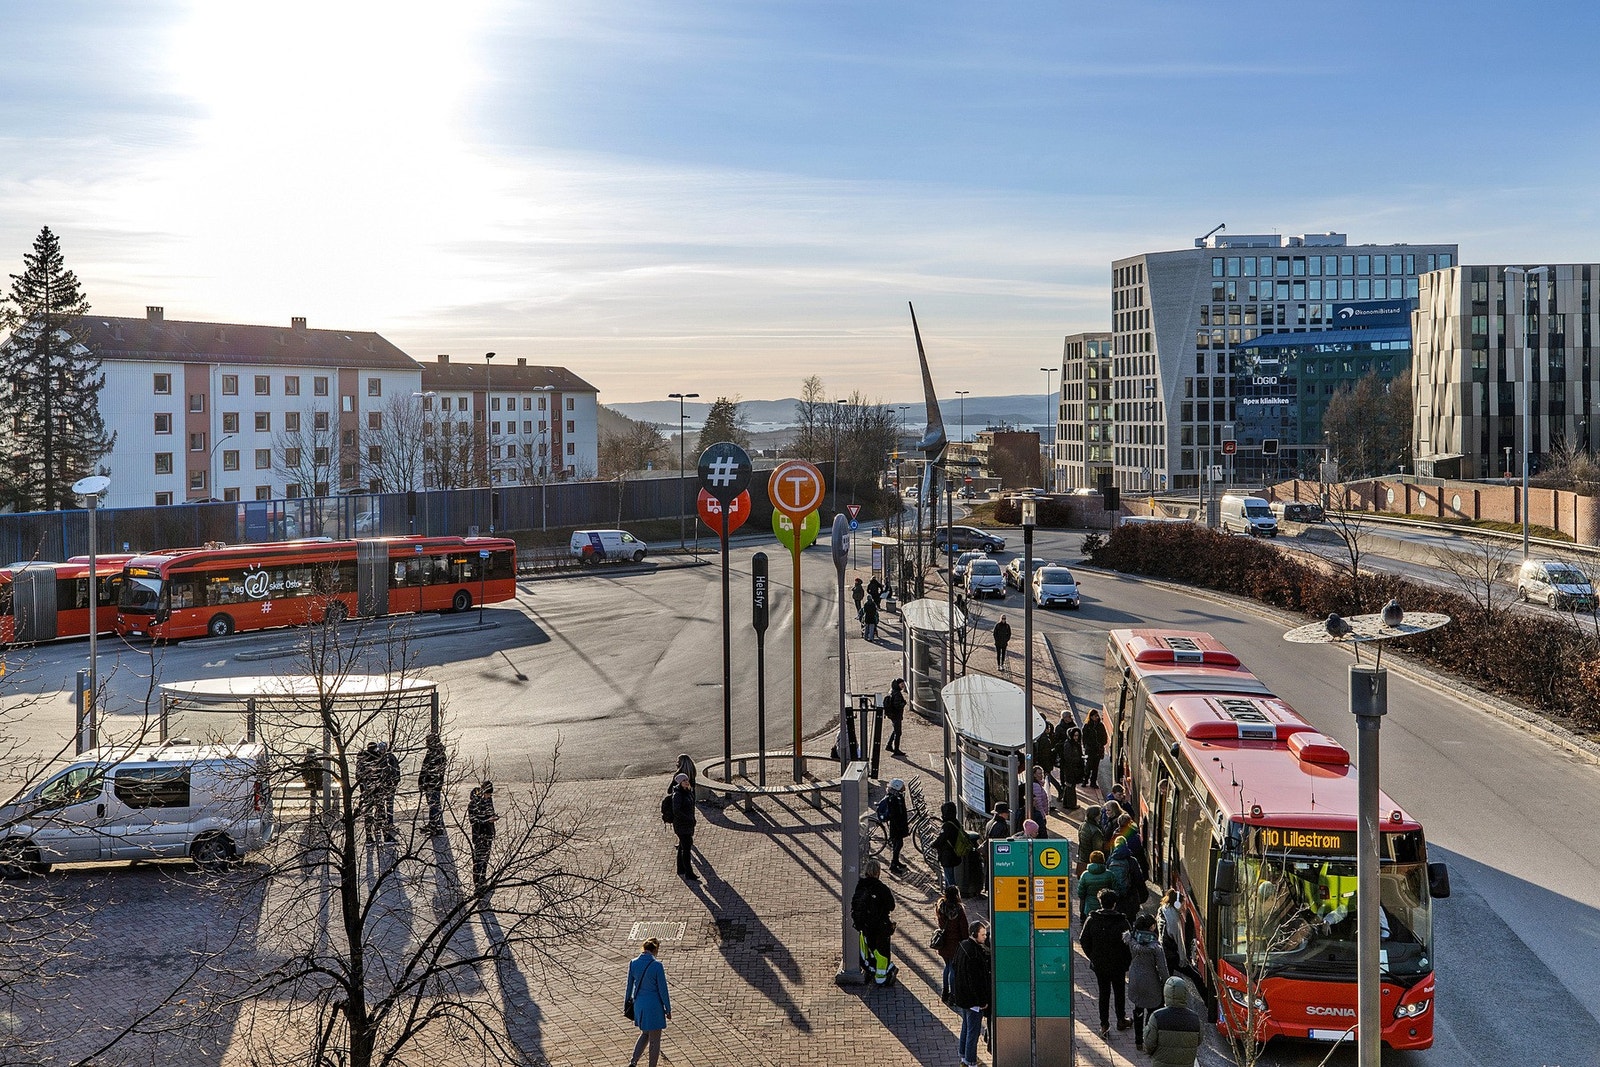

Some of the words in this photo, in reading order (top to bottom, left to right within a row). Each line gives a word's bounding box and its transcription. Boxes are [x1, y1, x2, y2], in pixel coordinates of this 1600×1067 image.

[1253, 377, 1277, 385] LOGIQ
[785, 476, 808, 506] T
[231, 584, 244, 595] Jeg
[755, 575, 766, 608] Helsfyr
[1283, 830, 1340, 848] Lillestrøm
[1045, 851, 1055, 865] E
[1223, 973, 1238, 984] 1435
[1305, 1005, 1357, 1018] SCANIA
